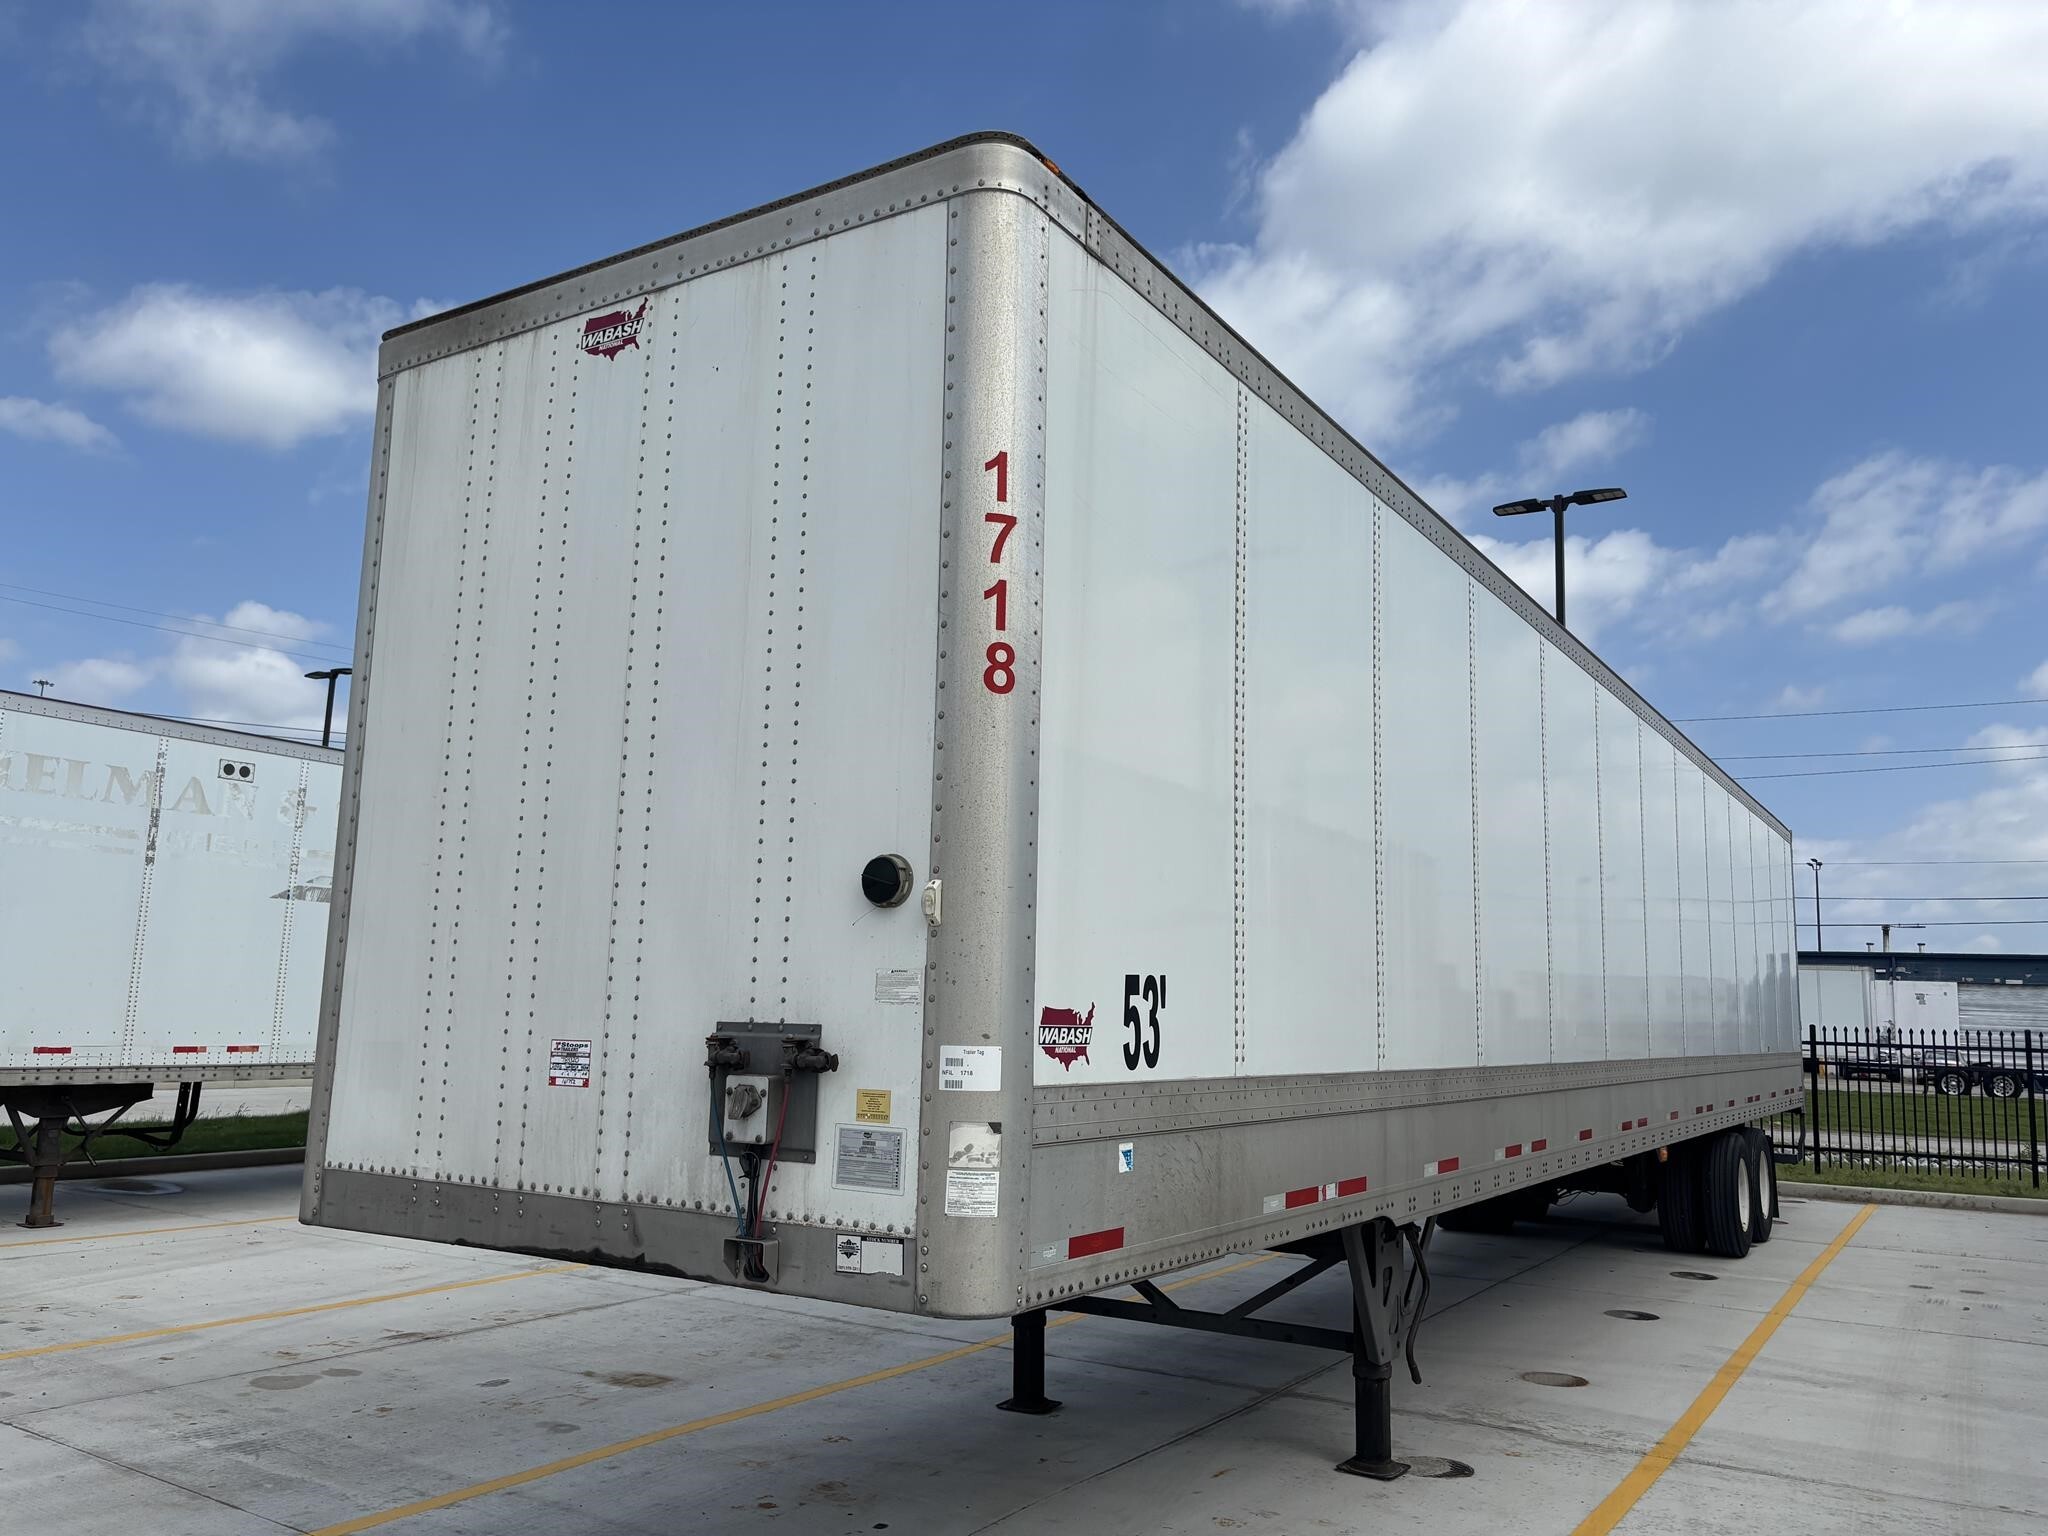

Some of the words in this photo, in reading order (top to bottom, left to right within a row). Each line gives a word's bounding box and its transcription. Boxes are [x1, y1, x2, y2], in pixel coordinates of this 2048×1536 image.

[582, 318, 643, 349] WABASH
[983, 451, 1017, 695] 1718
[1039, 1027, 1092, 1044] WABASH
